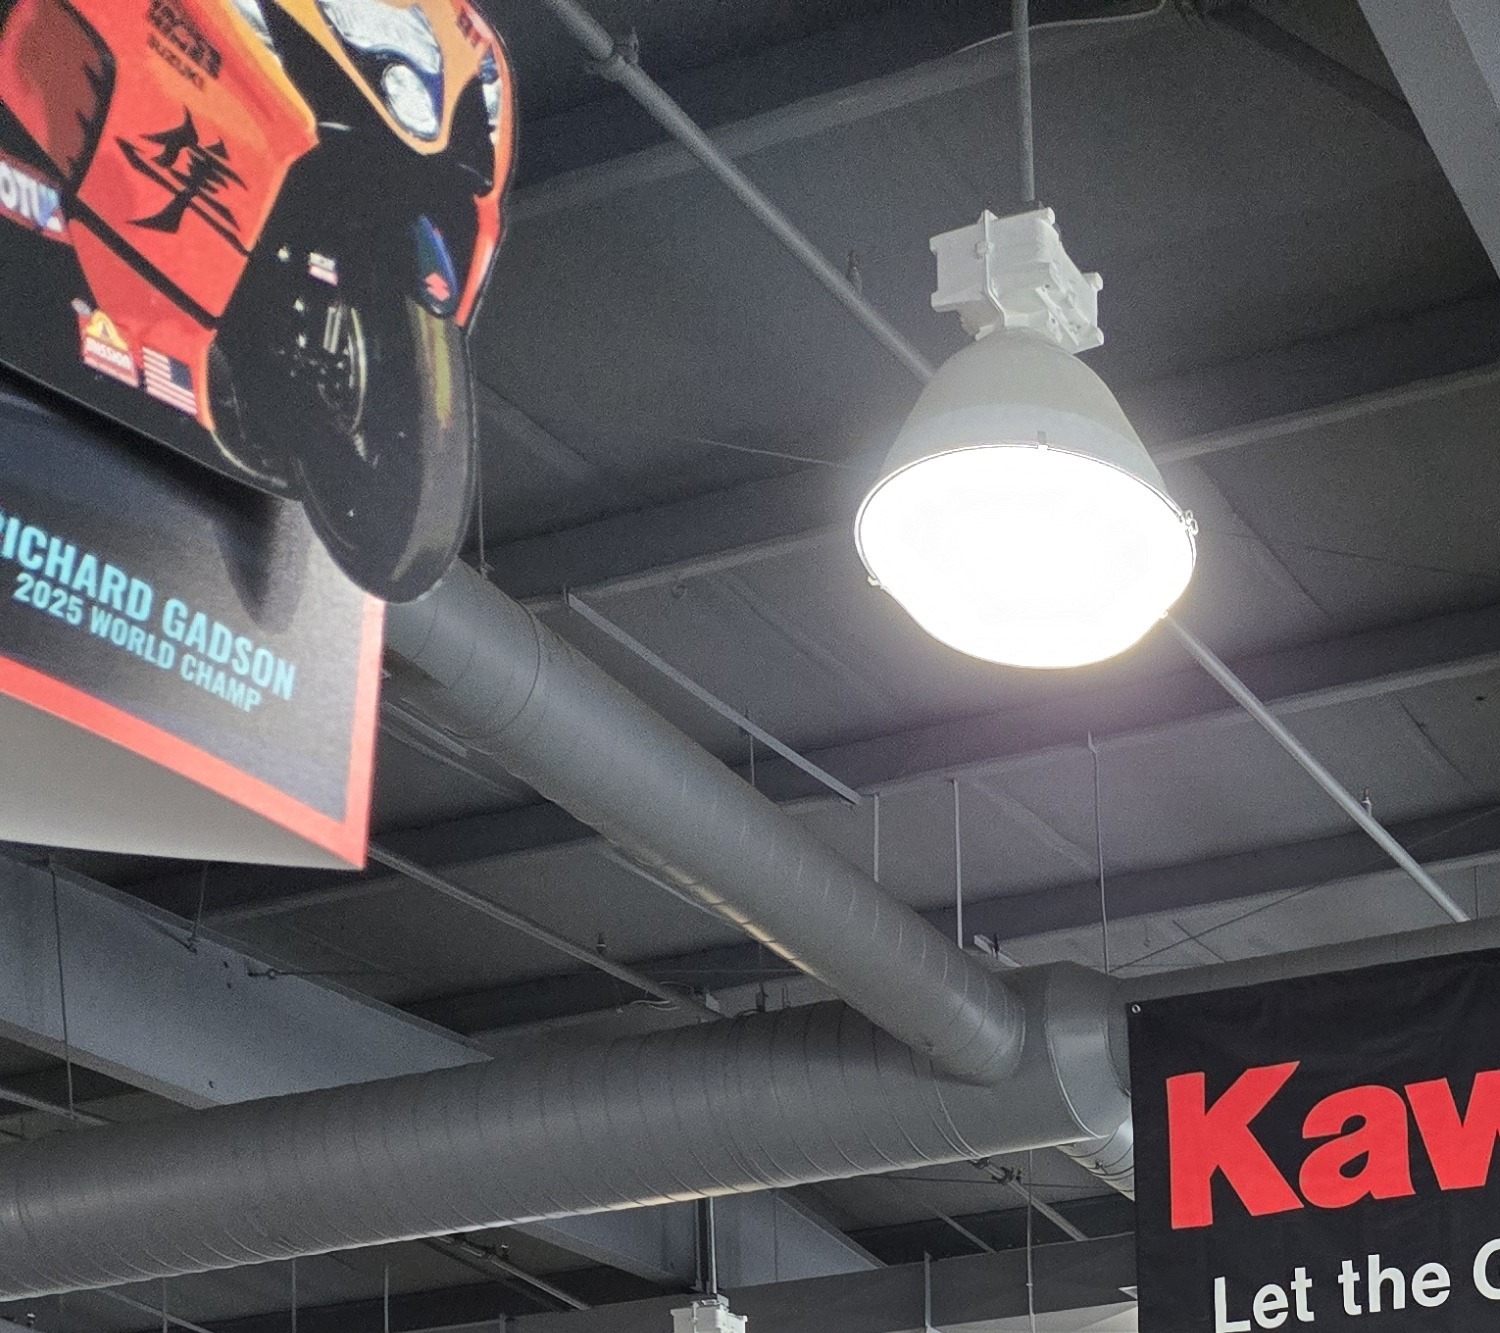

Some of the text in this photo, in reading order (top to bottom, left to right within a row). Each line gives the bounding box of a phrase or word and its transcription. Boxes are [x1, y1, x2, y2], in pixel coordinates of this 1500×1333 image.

[0, 509, 297, 701] ICHARD GADSON
[13, 572, 262, 712] 2025 WORLD CHAMP
[1338, 1253, 1452, 1318] the
